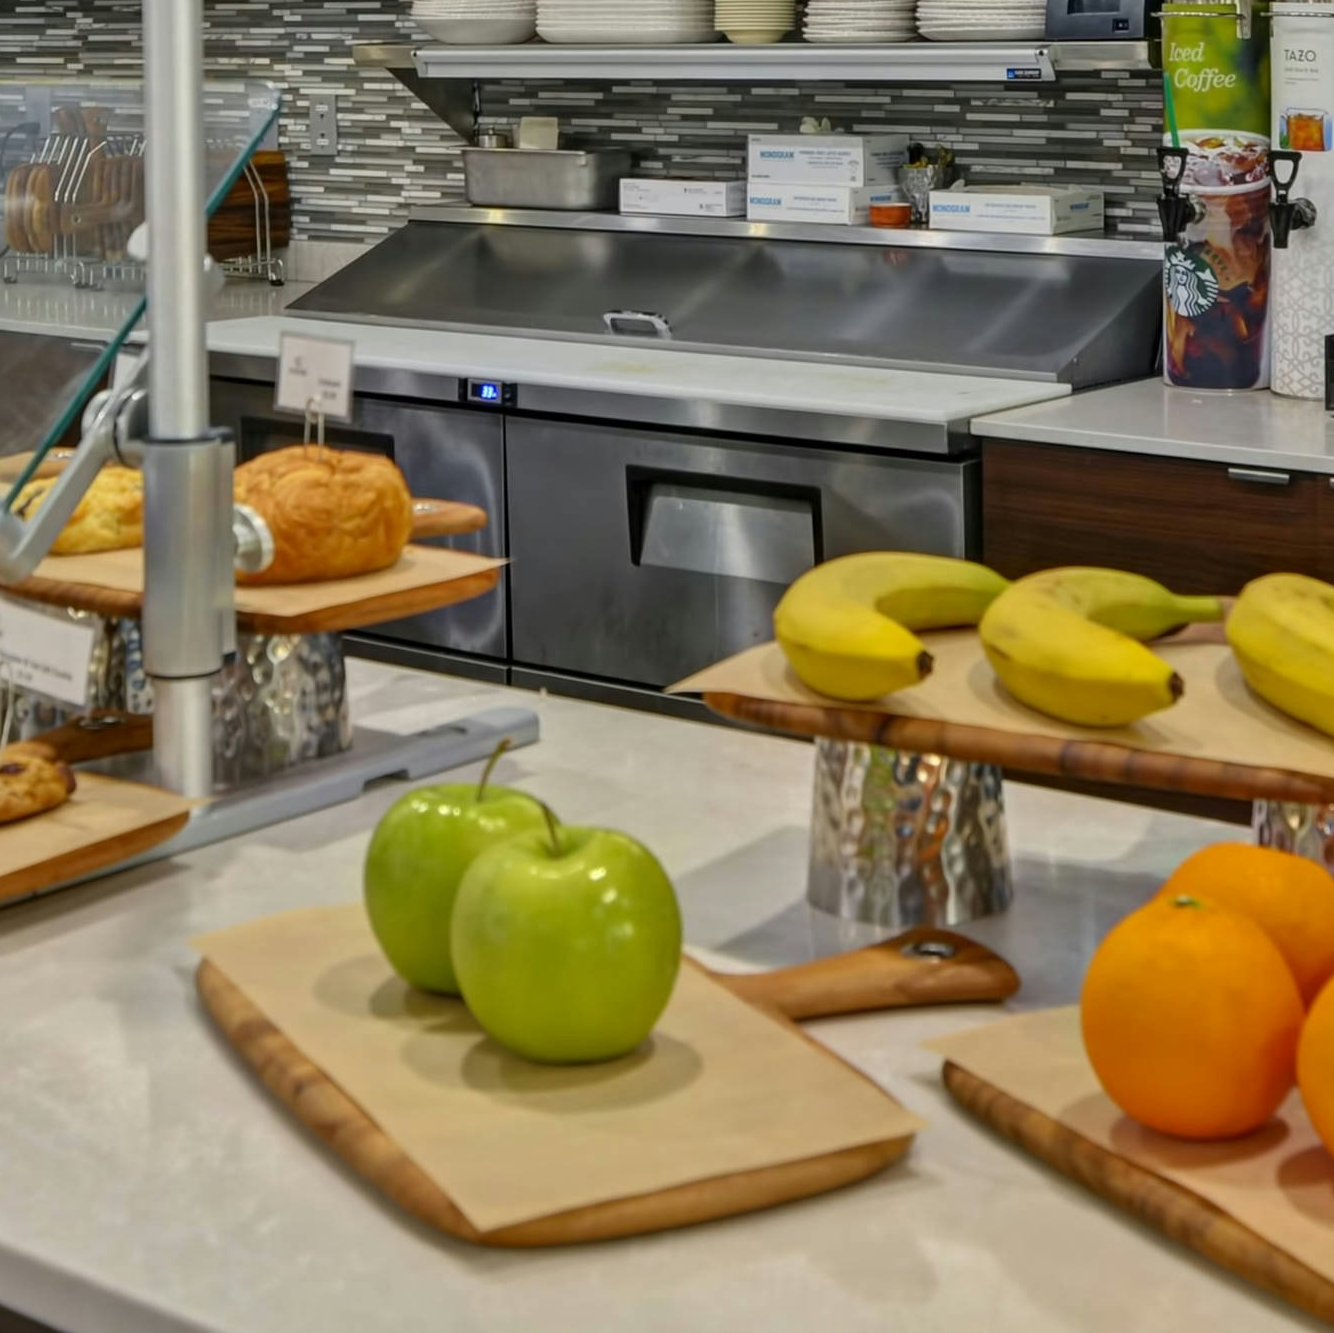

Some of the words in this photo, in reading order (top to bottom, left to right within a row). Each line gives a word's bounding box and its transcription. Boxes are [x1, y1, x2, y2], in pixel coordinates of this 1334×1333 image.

[1168, 41, 1207, 63] Iced
[1283, 49, 1318, 63] TAZO
[1173, 68, 1237, 92] Coffee
